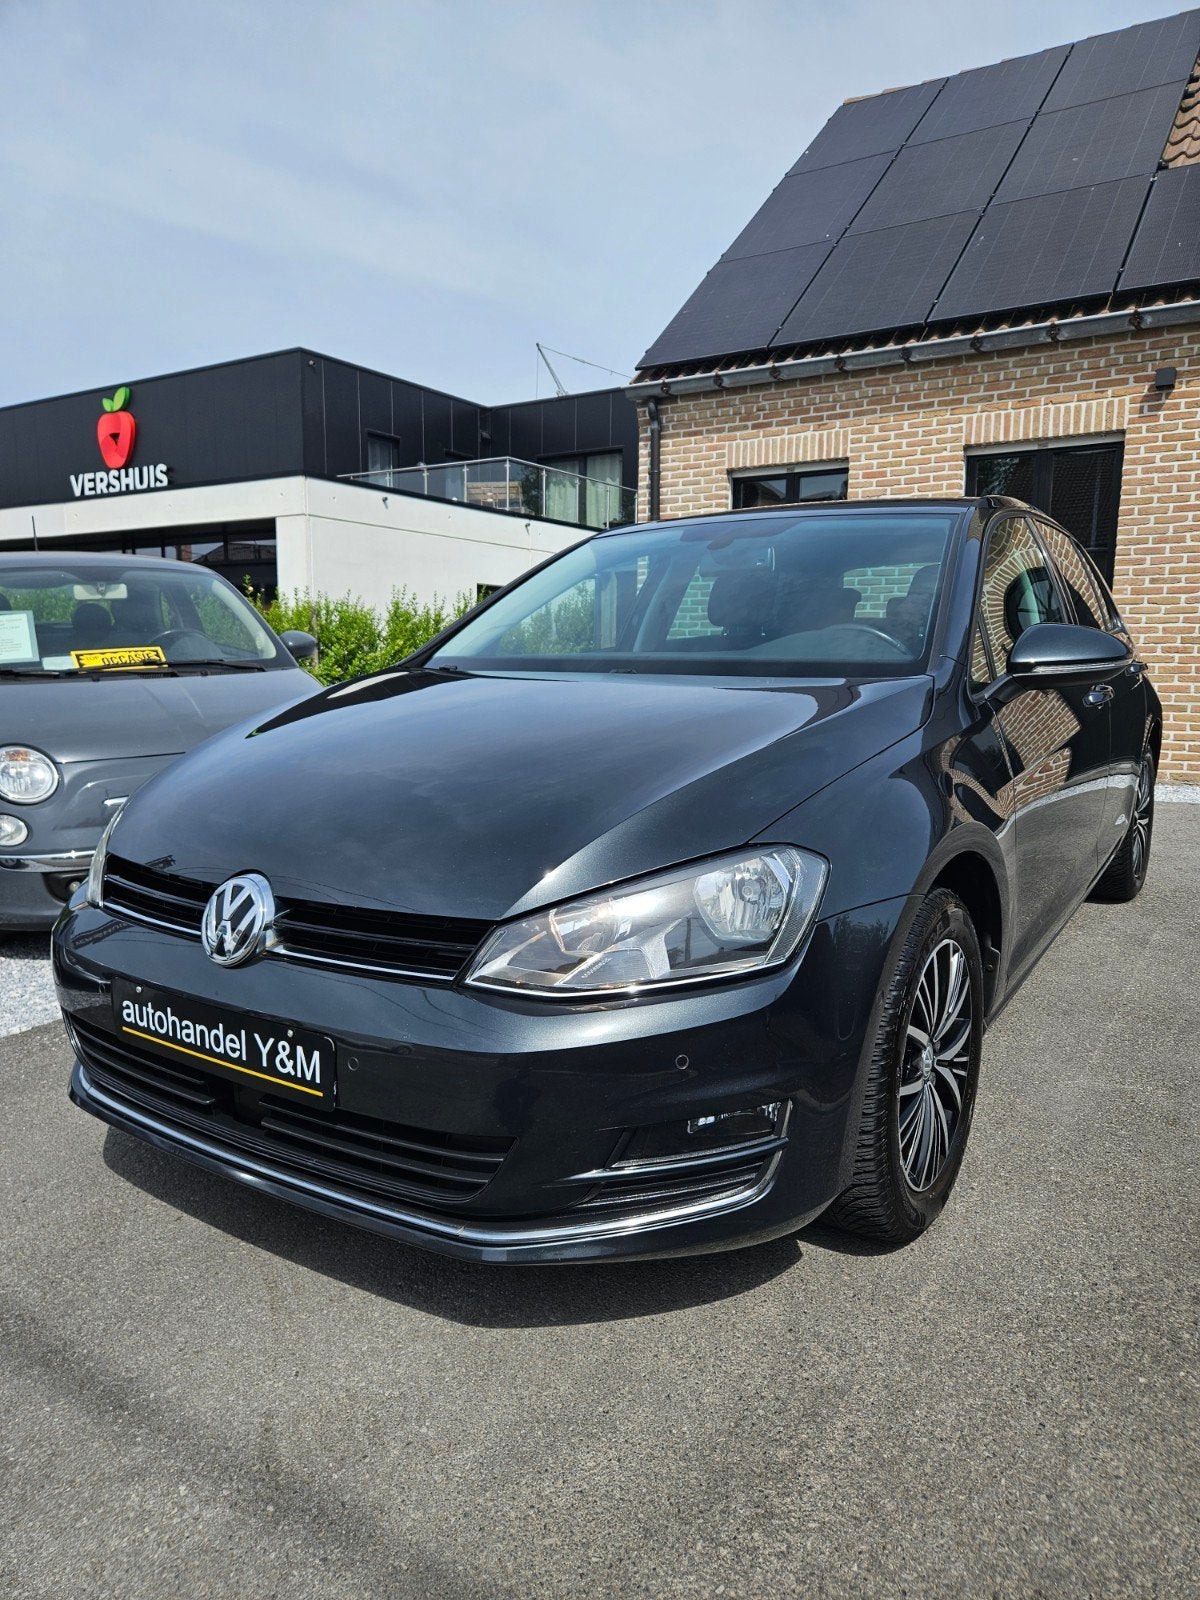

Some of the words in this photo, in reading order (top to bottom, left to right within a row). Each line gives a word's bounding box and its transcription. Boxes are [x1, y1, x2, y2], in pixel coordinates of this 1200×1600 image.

[69, 463, 169, 497] VERSHUIS
[122, 1000, 247, 1061] autohandel
[253, 1032, 321, 1084] Y&M
